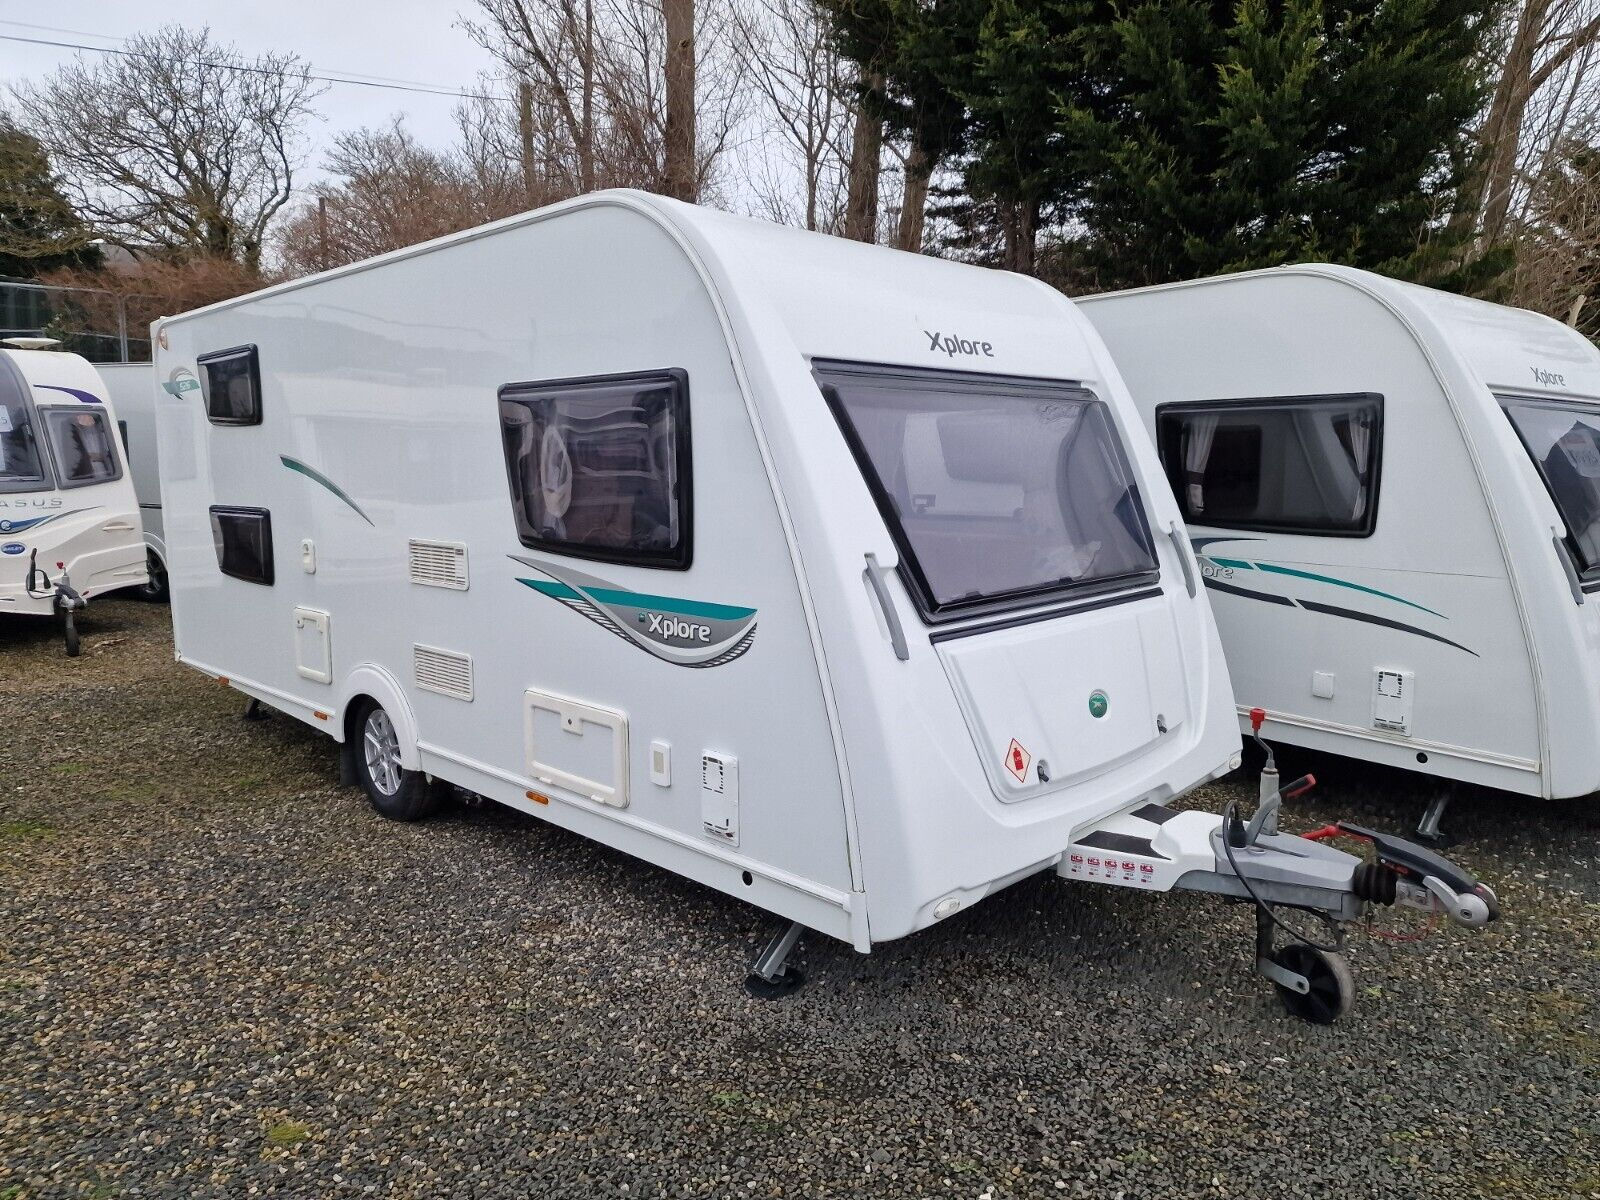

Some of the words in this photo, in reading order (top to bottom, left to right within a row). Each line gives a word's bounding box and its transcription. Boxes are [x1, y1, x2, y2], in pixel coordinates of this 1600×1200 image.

[924, 330, 994, 357] Xplore
[1530, 366, 1567, 387] Xplore
[648, 612, 711, 642] Xplore
